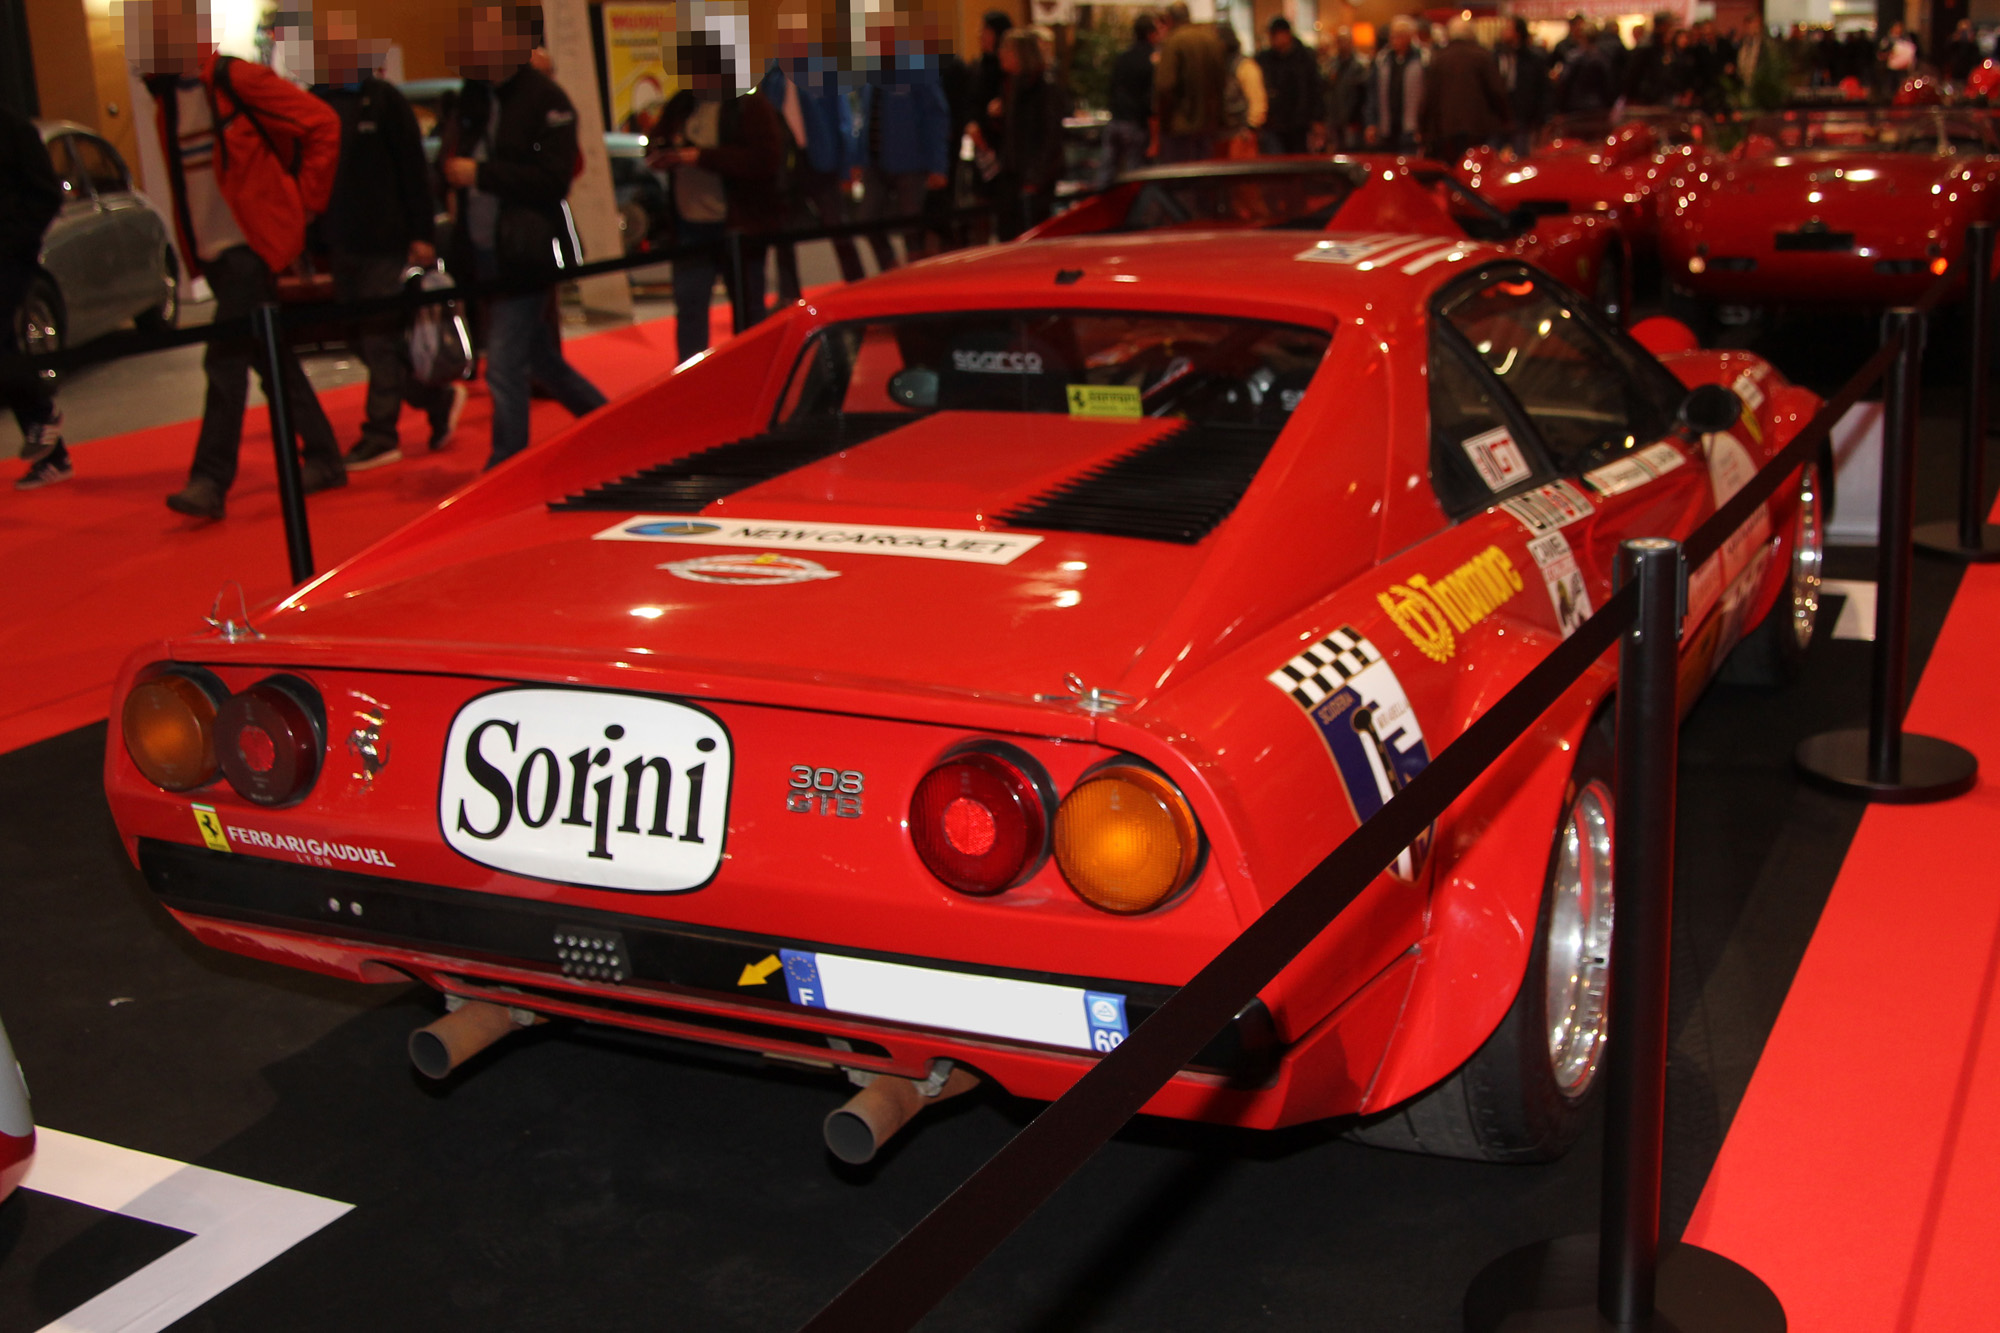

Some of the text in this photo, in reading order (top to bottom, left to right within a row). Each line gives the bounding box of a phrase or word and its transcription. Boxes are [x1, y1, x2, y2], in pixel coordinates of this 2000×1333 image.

[730, 526, 817, 541] NEW
[457, 719, 717, 860] Sorini
[788, 764, 865, 794] 308
[786, 789, 863, 819] GTB
[227, 825, 396, 868] FERRARI GAUDUEL
[296, 854, 333, 867] LYON
[798, 987, 815, 1006] F
